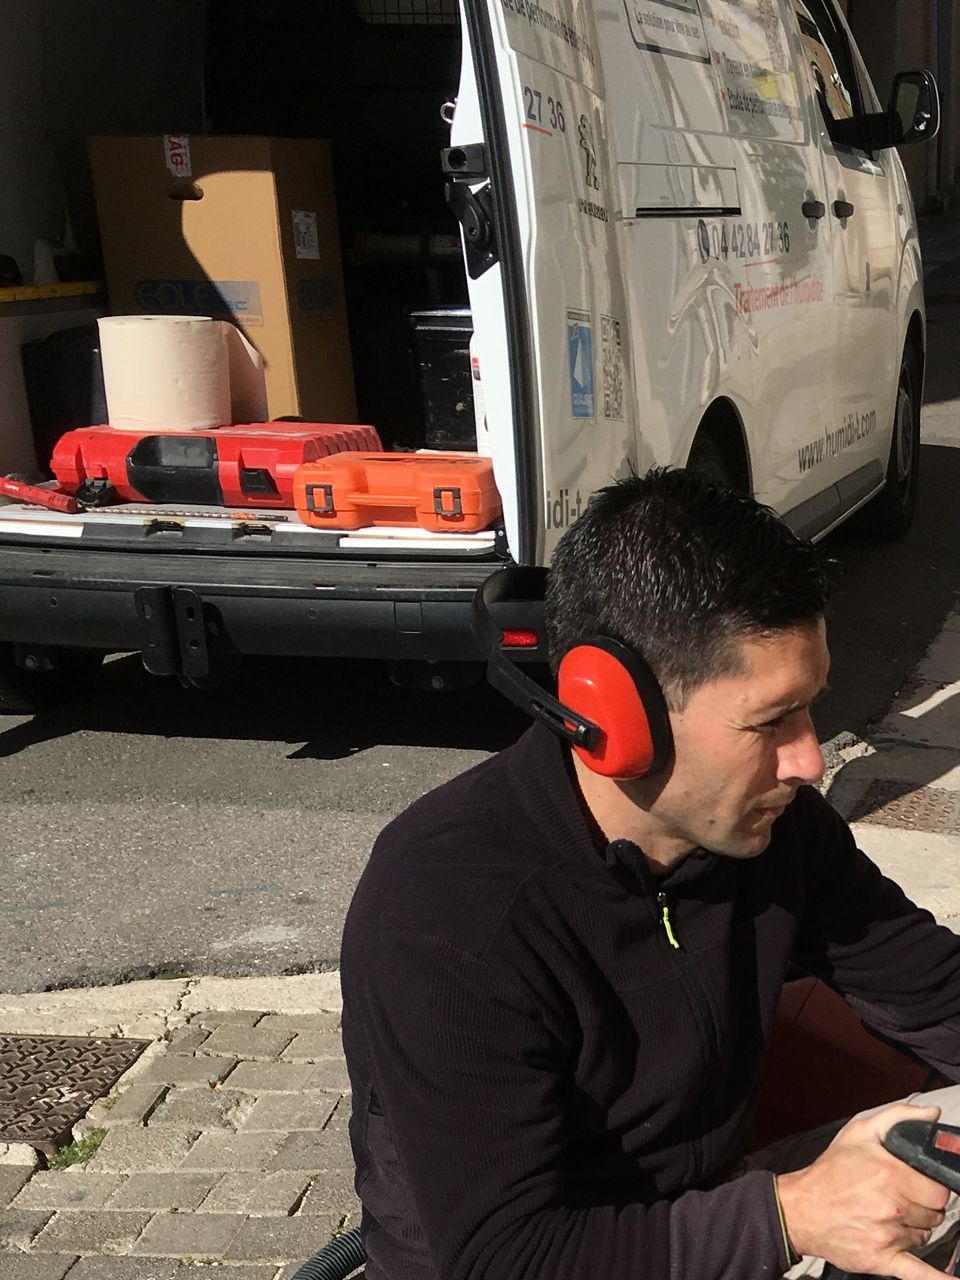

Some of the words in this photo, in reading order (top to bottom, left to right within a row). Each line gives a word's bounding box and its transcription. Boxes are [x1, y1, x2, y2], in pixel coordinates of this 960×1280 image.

[525, 86, 542, 123] 27
[547, 96, 565, 133] 36
[712, 223, 729, 260] 04
[731, 222, 746, 259] 42
[746, 222, 761, 258] 84
[762, 221, 774, 255] 27
[777, 221, 790, 254] 36
